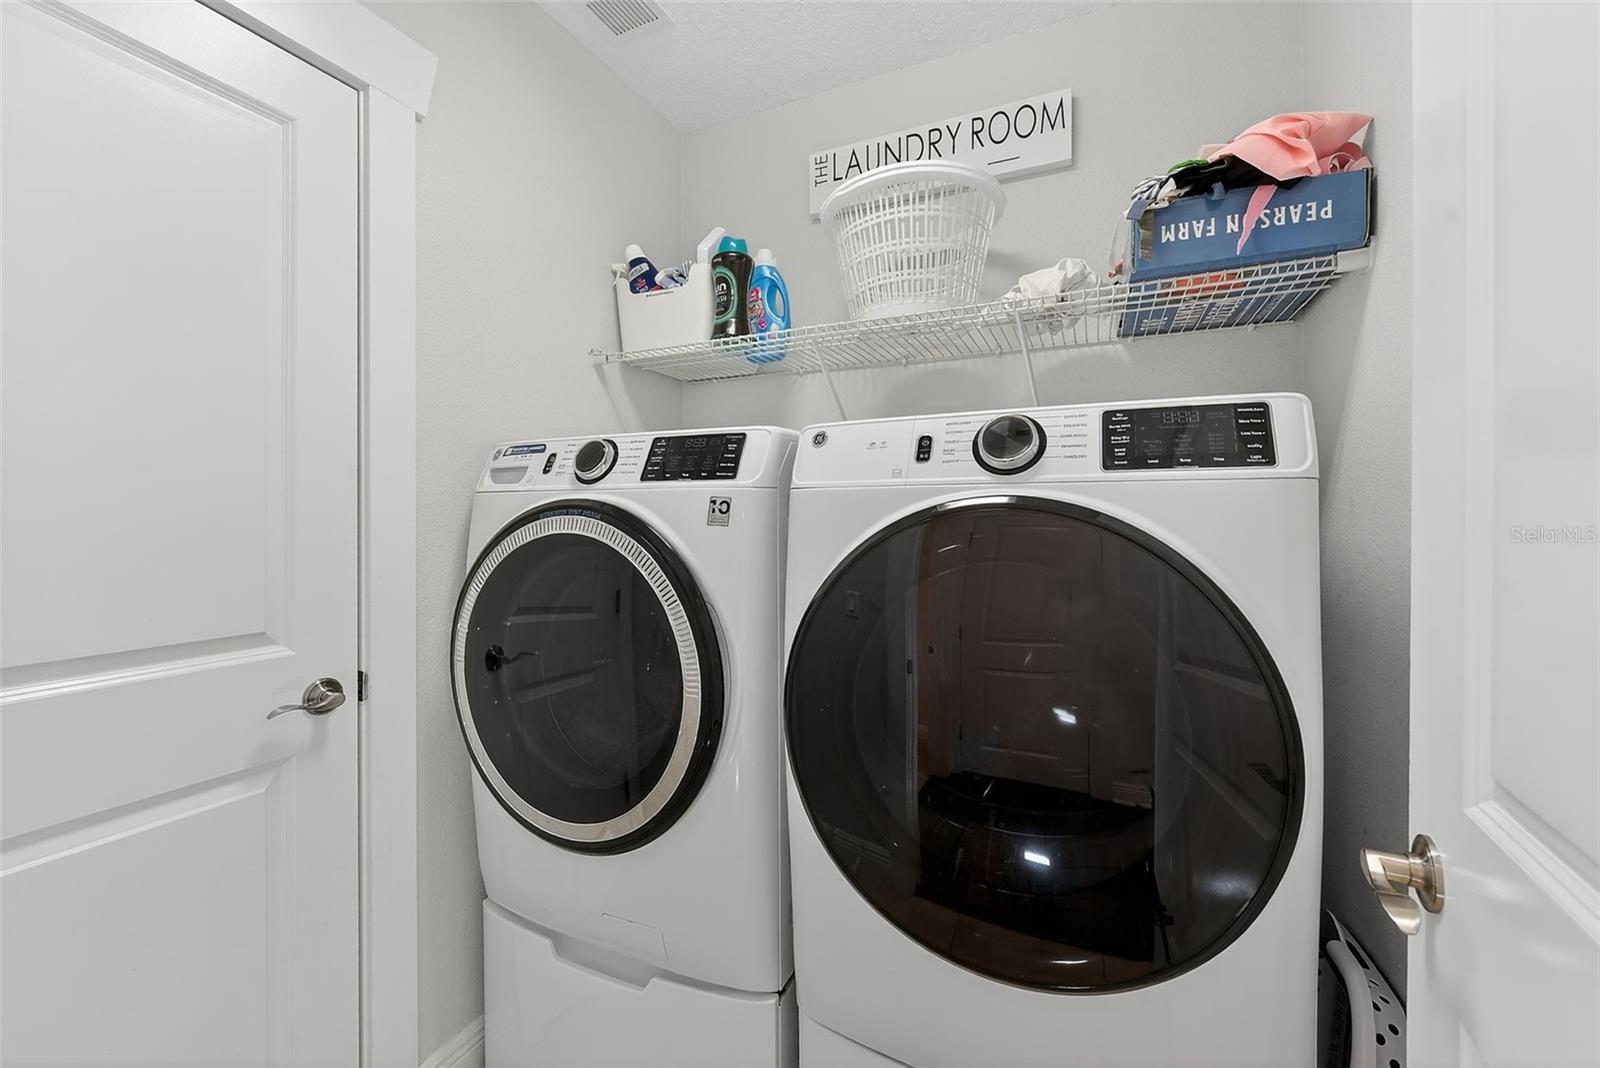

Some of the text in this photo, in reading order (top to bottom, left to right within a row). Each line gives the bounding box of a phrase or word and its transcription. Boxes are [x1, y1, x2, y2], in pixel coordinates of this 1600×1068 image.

[832, 97, 1066, 182] LAUNDRY ROOM
[814, 153, 829, 187] THE
[1160, 199, 1334, 244] PEARSN FARM
[710, 499, 731, 515] 10
